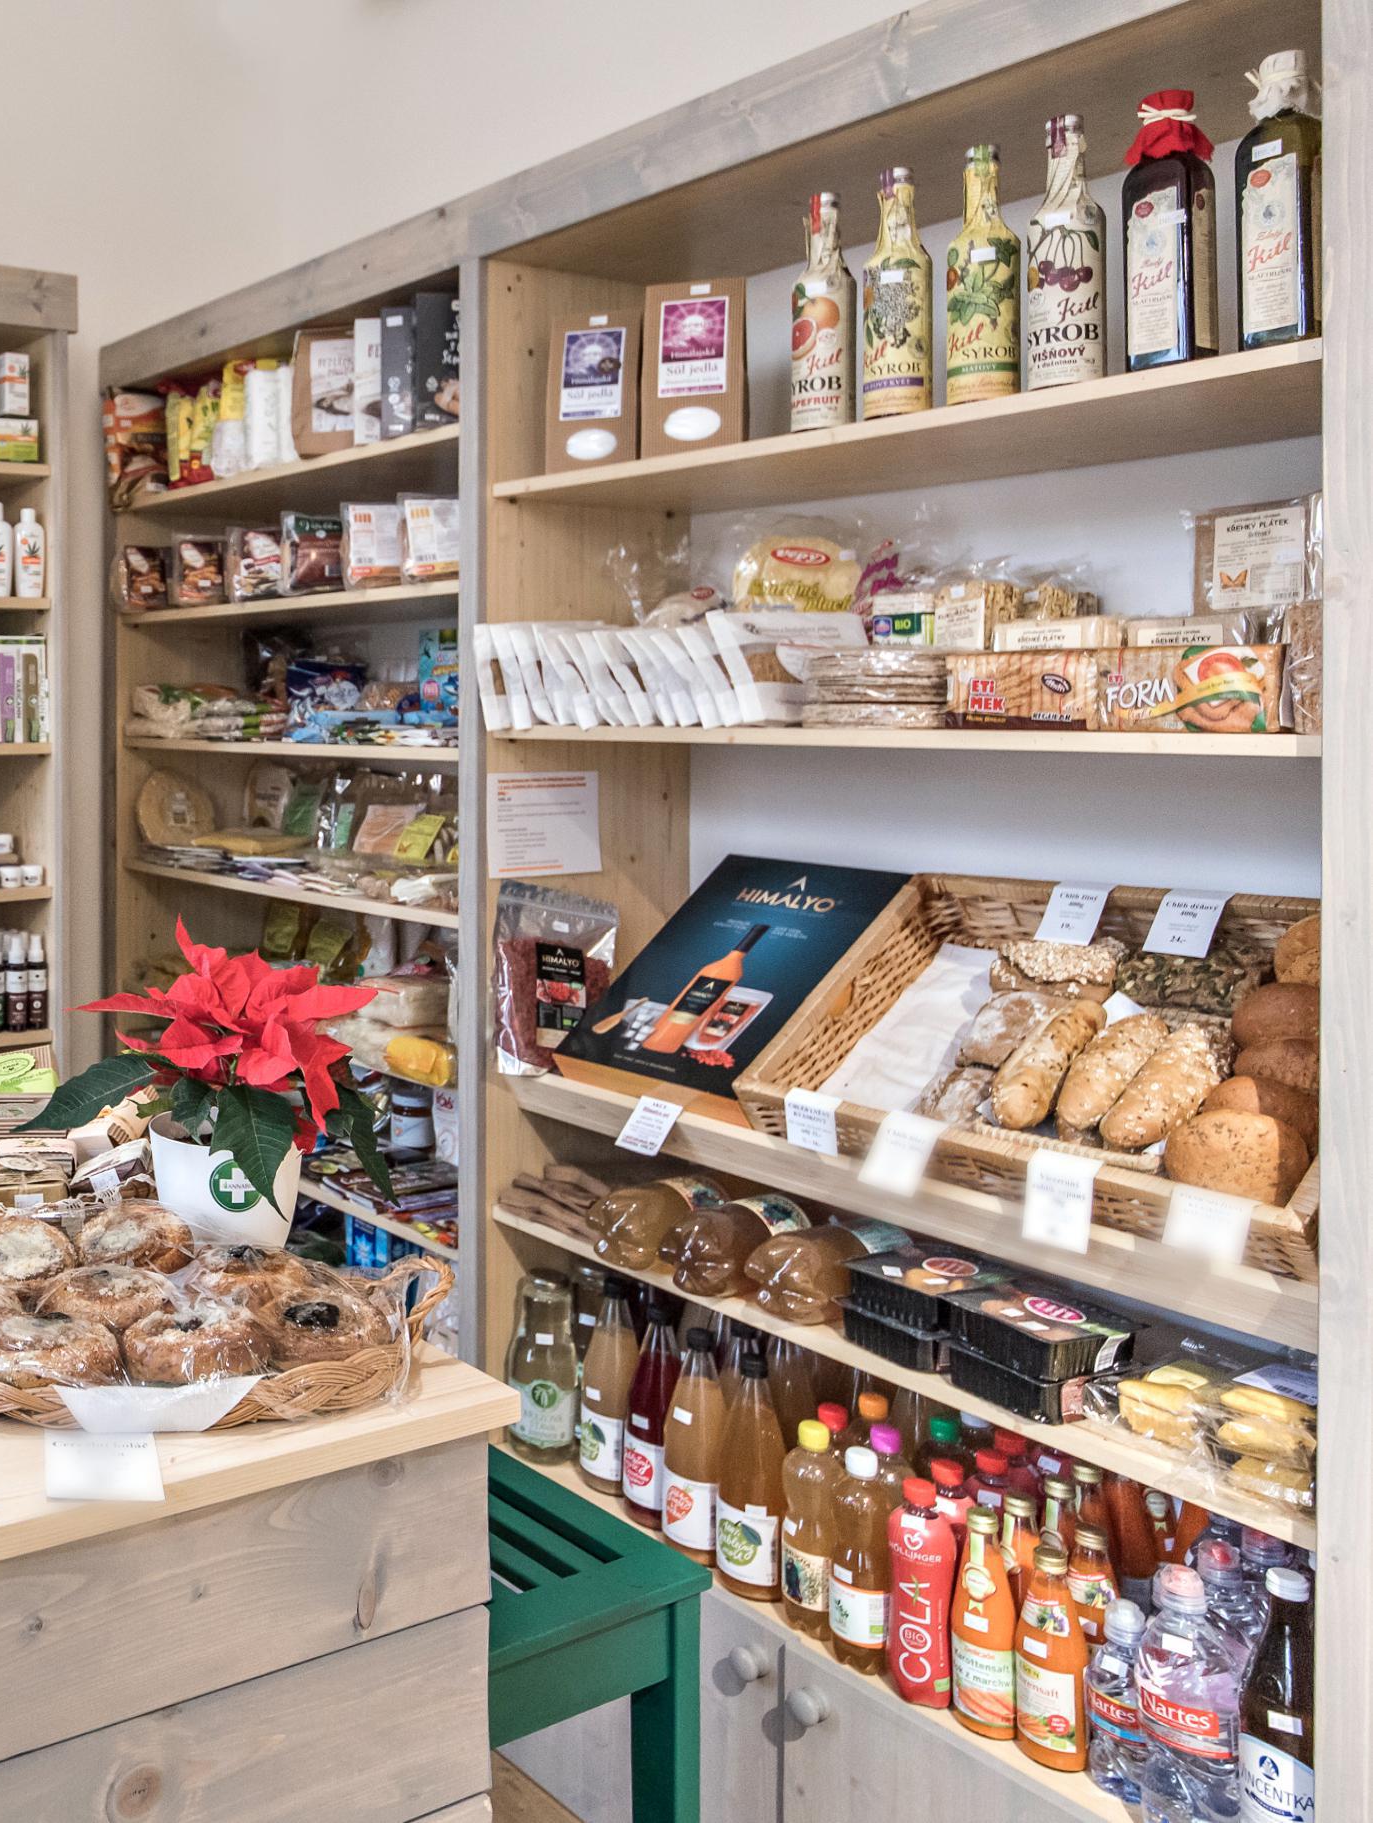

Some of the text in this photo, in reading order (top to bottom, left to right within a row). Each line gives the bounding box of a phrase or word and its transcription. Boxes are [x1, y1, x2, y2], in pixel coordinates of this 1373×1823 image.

[1246, 231, 1293, 274] Kitl
[1131, 260, 1173, 298] Kitl
[1057, 292, 1100, 324] Kitl
[948, 322, 985, 359] Kitl
[1027, 322, 1099, 349] SYROB
[806, 347, 843, 377] Kitl
[962, 346, 1017, 360] SYROB
[870, 361, 922, 374] SYROB
[791, 375, 842, 396] YROB
[894, 619, 912, 631] BIO
[969, 696, 1006, 714] MEK
[1106, 678, 1175, 713] FORM
[734, 887, 836, 914] HIMALYO
[541, 954, 580, 968] HIMALYO
[898, 1581, 932, 1684] COLA
[903, 1628, 926, 1644] BIO
[1142, 1688, 1212, 1731] Nartes
